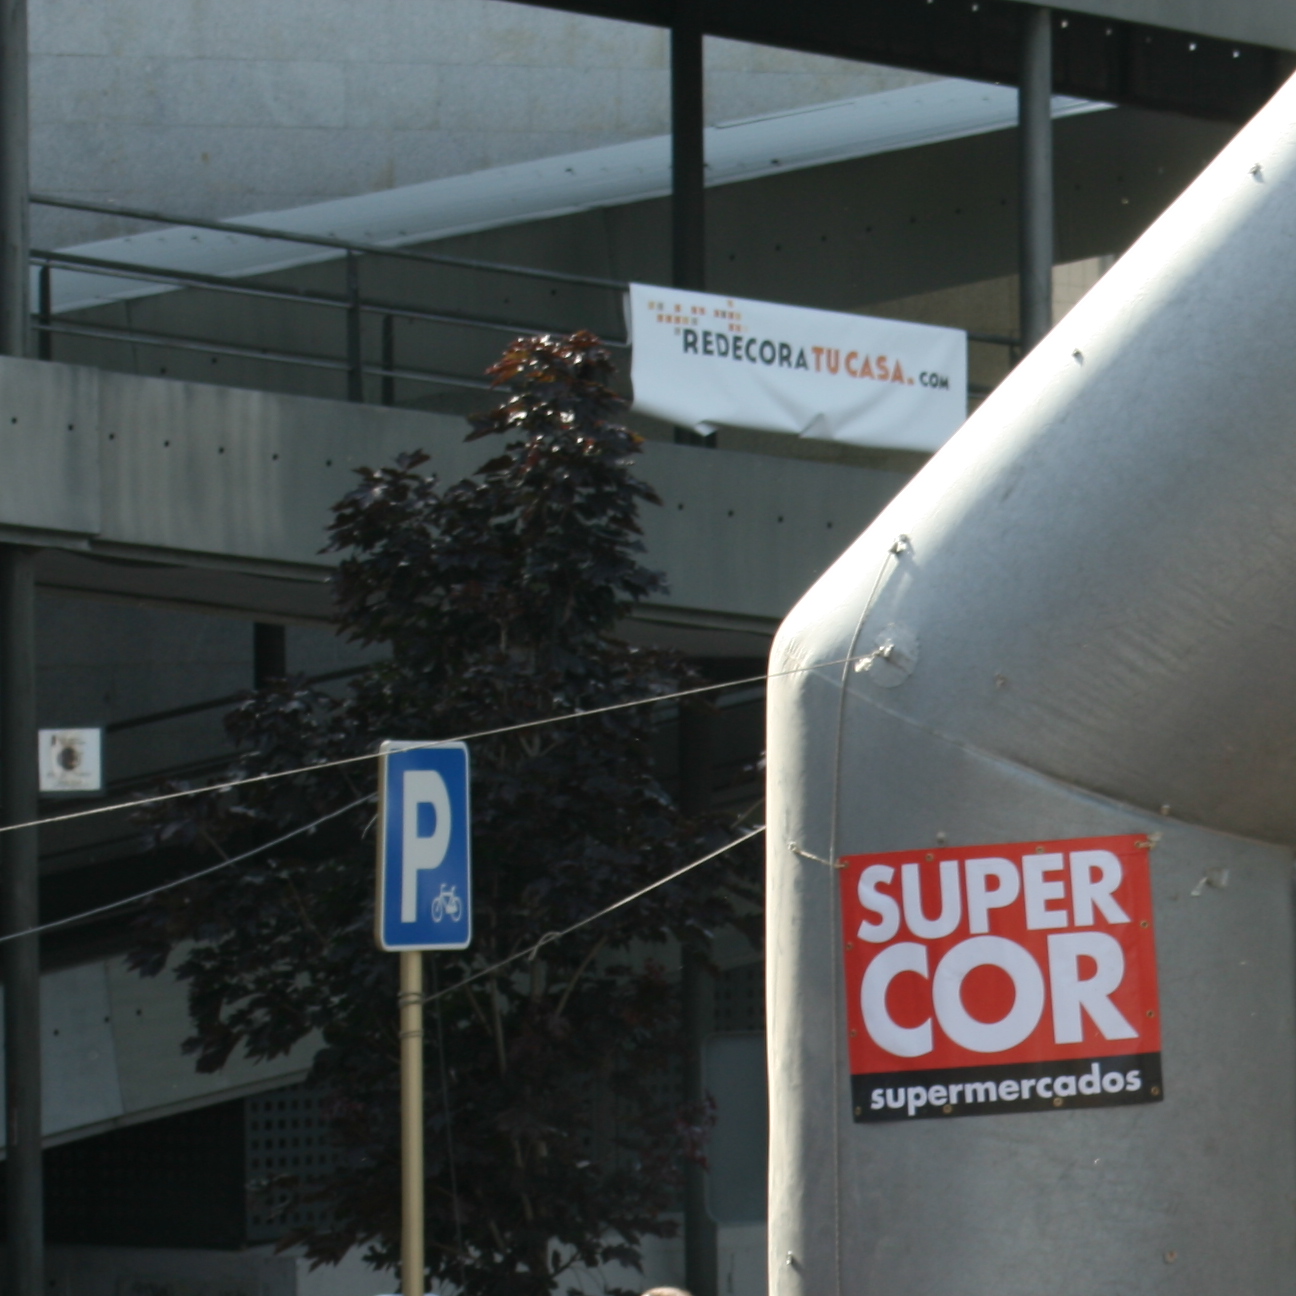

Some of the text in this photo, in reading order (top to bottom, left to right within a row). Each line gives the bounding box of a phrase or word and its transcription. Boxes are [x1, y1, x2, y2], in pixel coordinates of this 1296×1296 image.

[401, 769, 452, 925] P
[857, 849, 1131, 945] SUPER
[860, 931, 1140, 1059] COR
[870, 1062, 1142, 1116] supermercados
